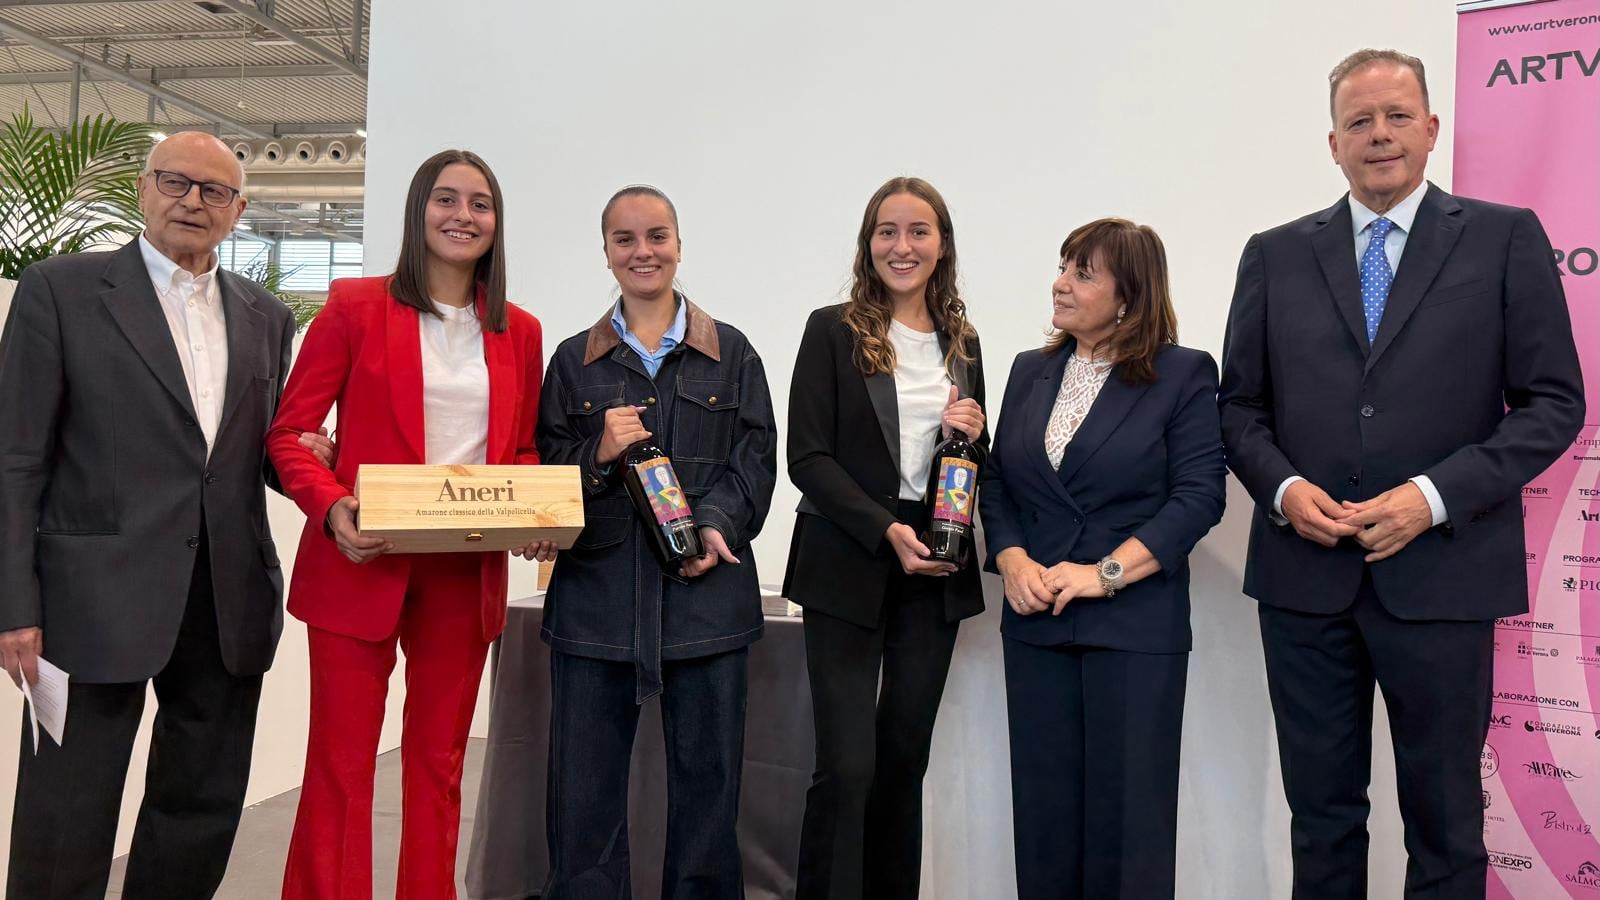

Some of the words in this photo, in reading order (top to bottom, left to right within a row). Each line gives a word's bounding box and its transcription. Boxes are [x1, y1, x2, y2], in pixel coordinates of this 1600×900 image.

[1486, 48, 1600, 88] ARTV
[435, 478, 516, 502] Aneri
[449, 508, 476, 516] classico
[477, 508, 494, 516] della
[496, 507, 536, 517] Valpolicella
[1512, 619, 1554, 630] PARTNER
[1558, 699, 1579, 708] CON
[1534, 725, 1581, 737] CARIVERONA
